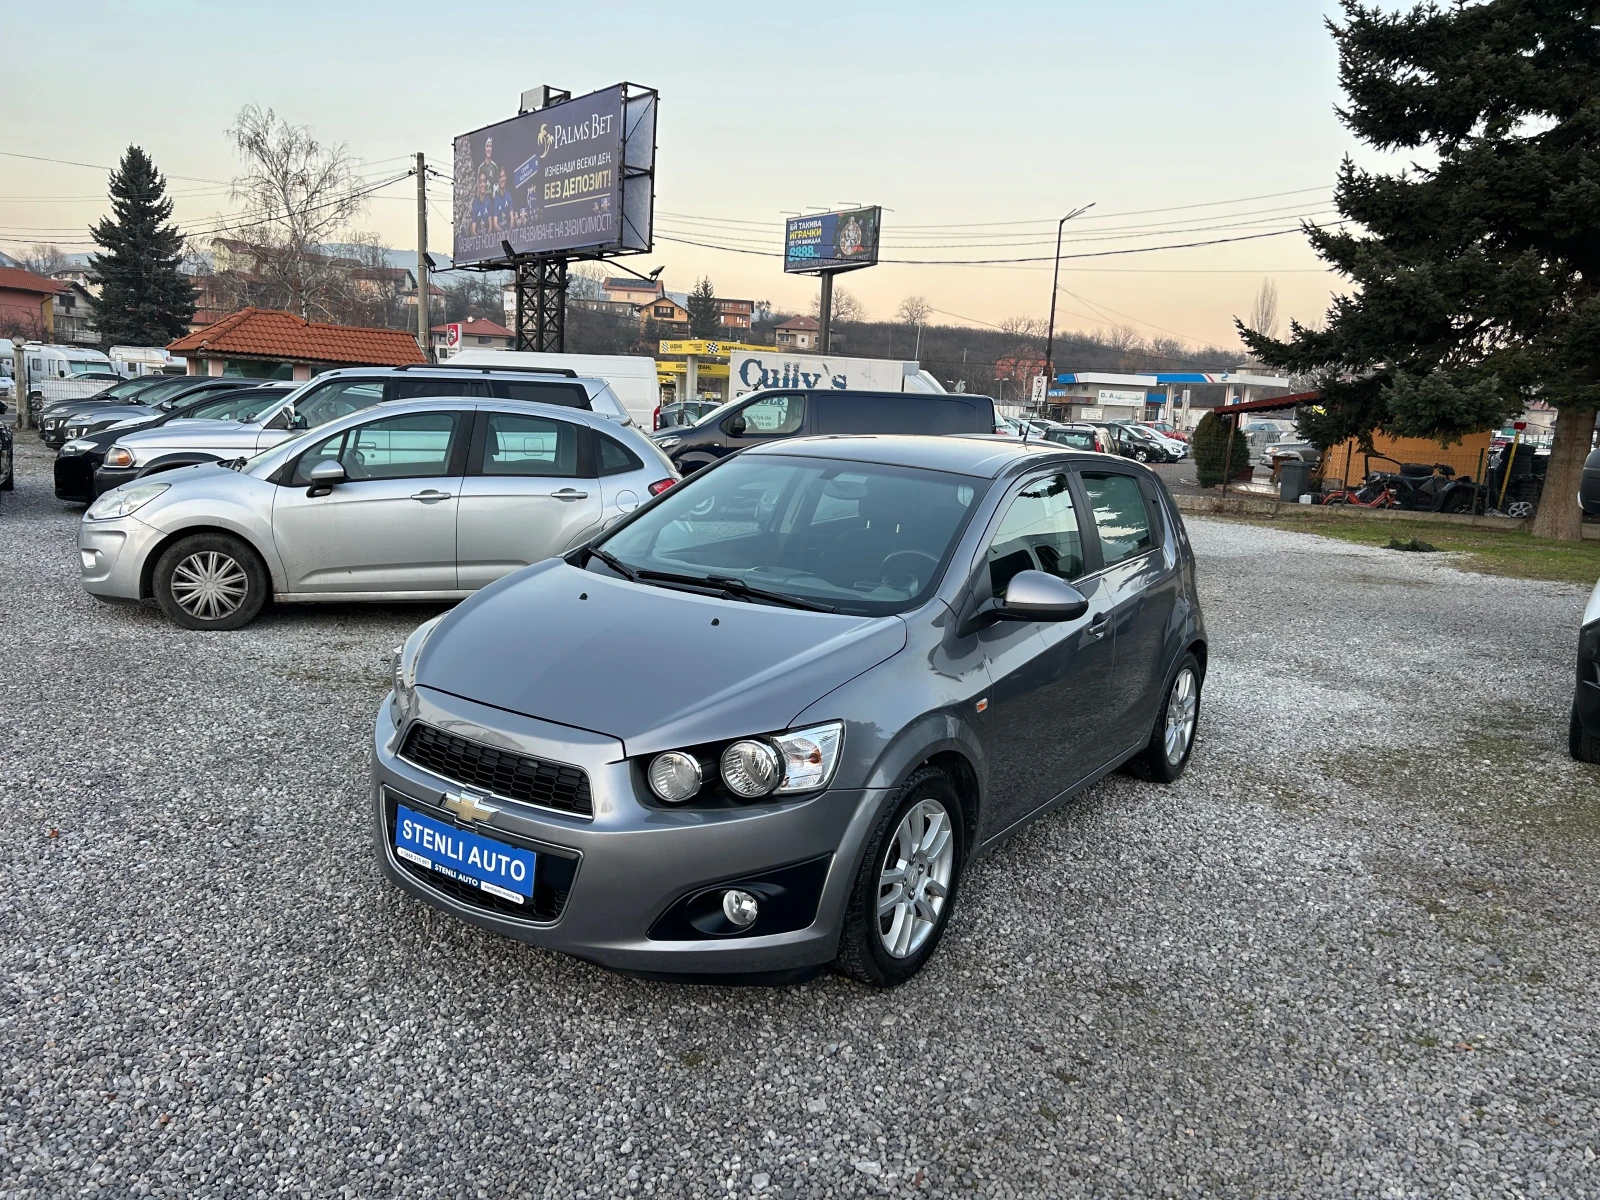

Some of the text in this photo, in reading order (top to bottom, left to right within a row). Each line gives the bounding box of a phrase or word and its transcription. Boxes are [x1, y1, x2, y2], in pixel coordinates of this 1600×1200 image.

[554, 113, 614, 149] PALMS BET
[544, 160, 576, 177] ИЗНЕНАДИ
[576, 155, 597, 170] ВСЕКИ
[544, 181, 562, 200] БЕЗ
[563, 169, 612, 199] ДЕПОЗИТ!
[554, 220, 564, 238] НА
[564, 213, 612, 237] ЗАВИСИМОСТ!
[789, 228, 822, 240] ИГРАЧКИ
[790, 220, 822, 230] ЕЙ ТАКИВА
[402, 819, 526, 882] STENLI AUTO
[434, 863, 479, 887] STENLI AUTO
